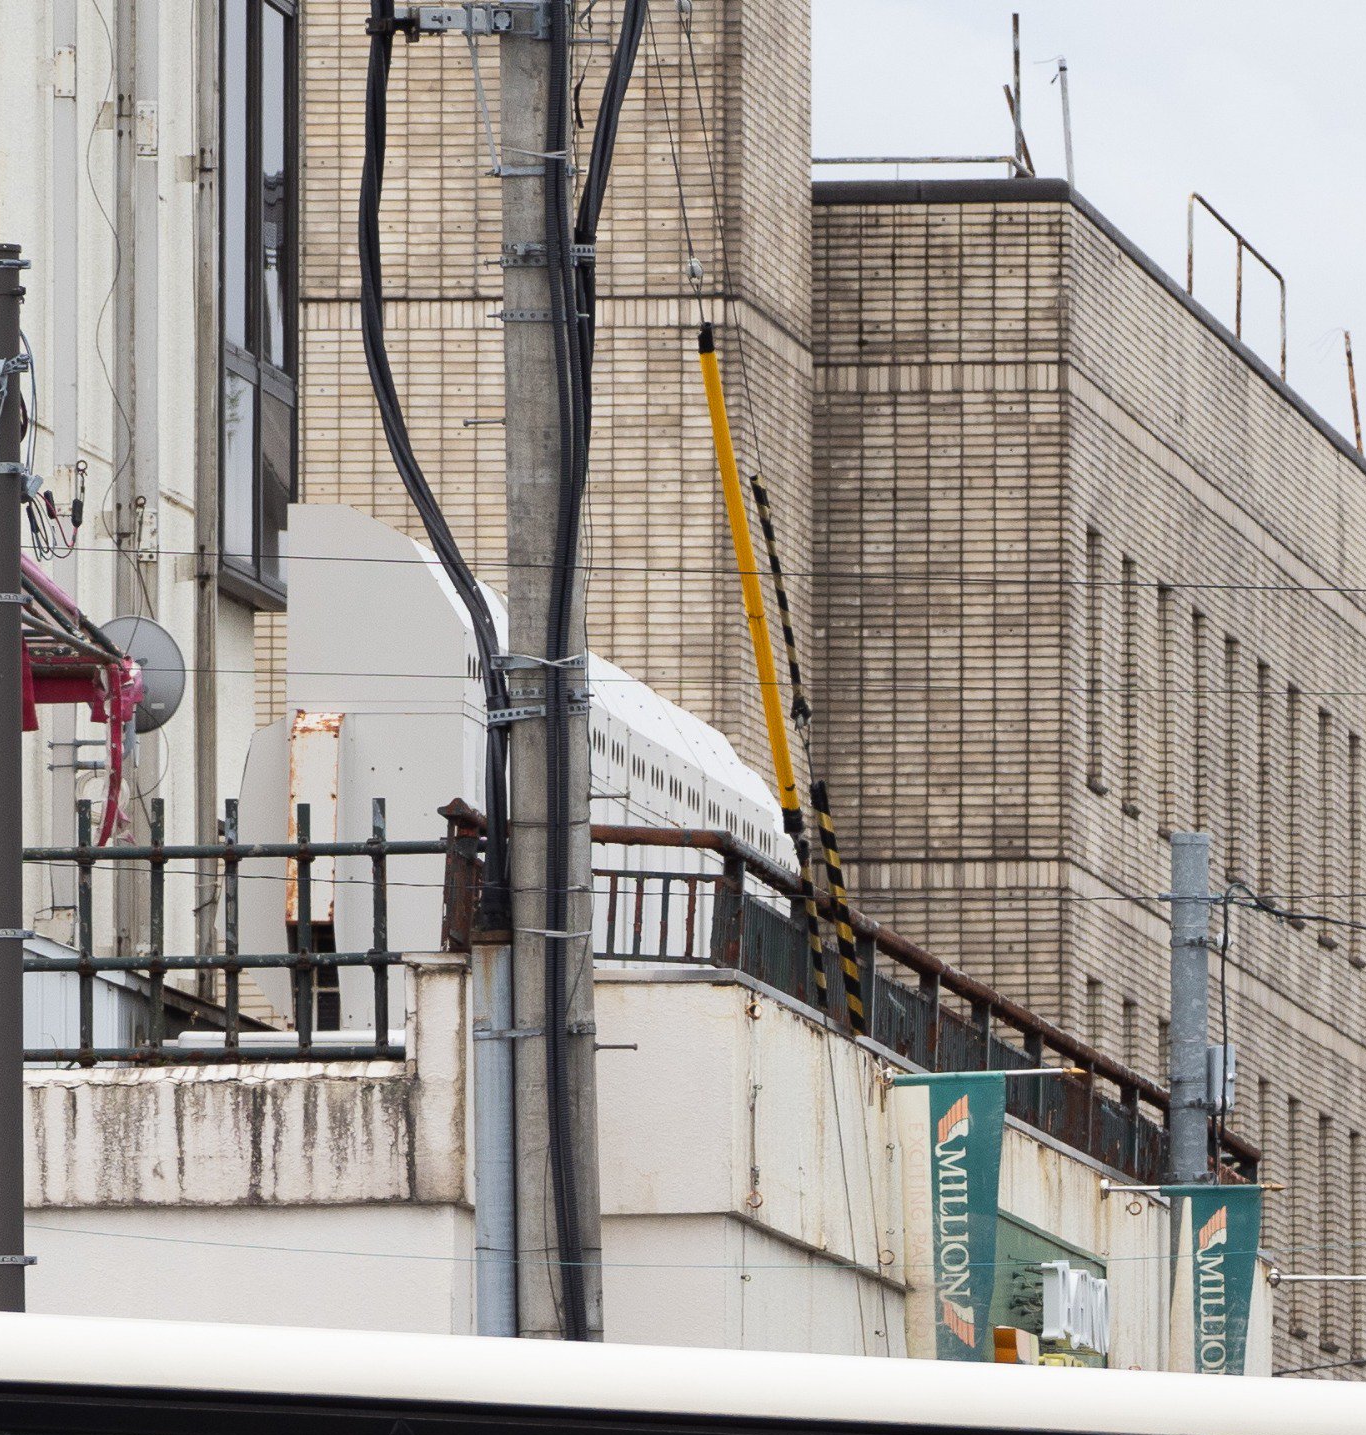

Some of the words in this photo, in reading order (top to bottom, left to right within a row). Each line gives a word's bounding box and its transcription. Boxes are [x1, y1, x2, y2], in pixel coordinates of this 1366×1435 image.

[908, 1121, 927, 1221] EXCITING
[936, 1142, 972, 1300] MILLION
[1196, 1249, 1227, 1374] MILLIO
